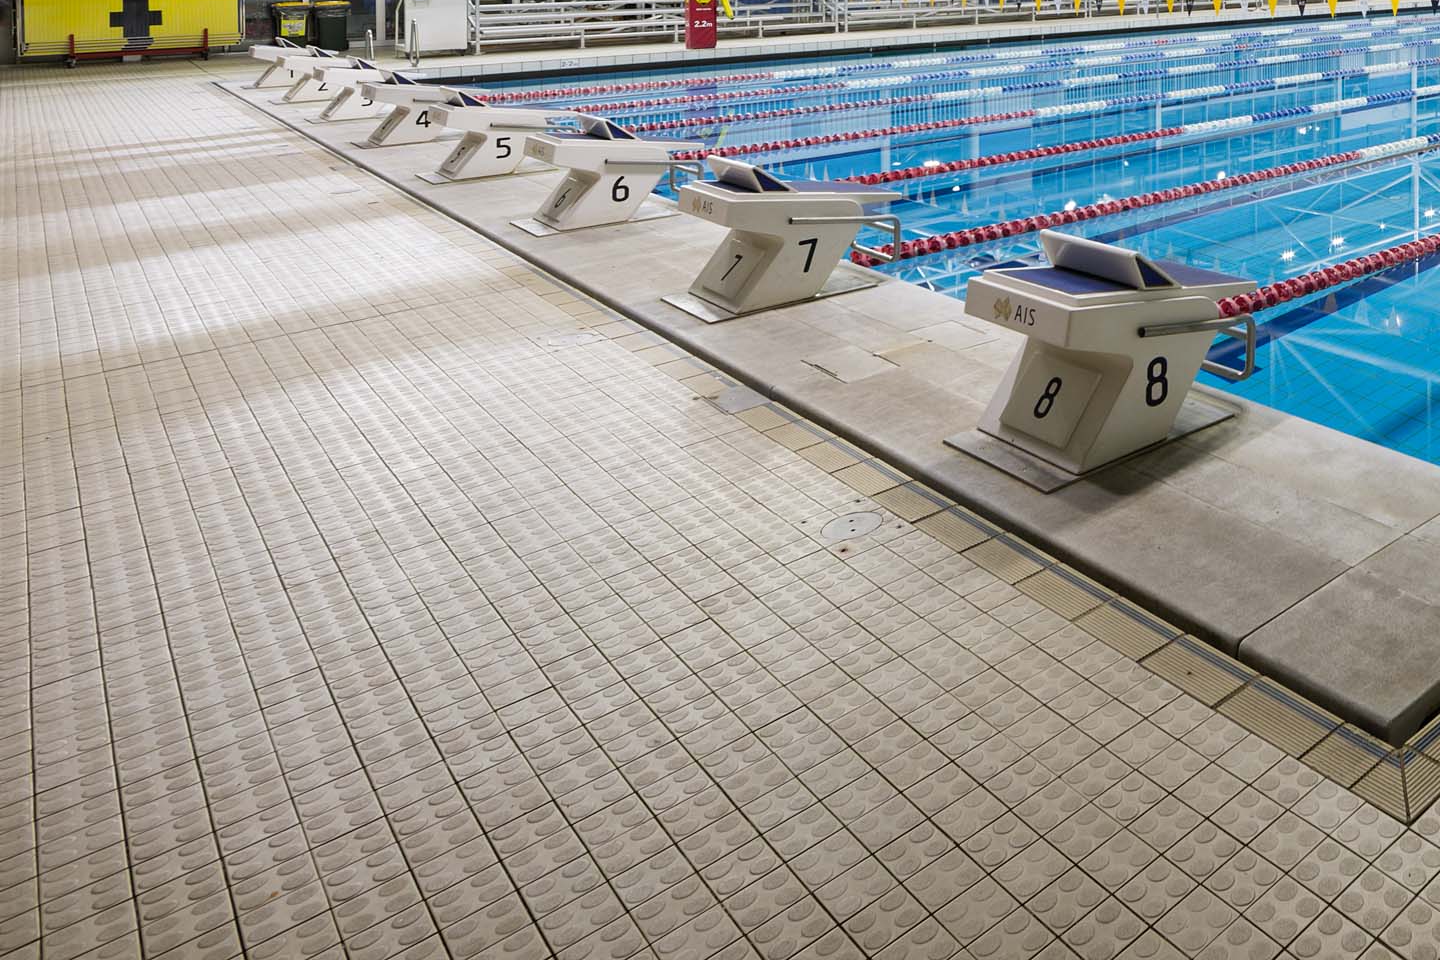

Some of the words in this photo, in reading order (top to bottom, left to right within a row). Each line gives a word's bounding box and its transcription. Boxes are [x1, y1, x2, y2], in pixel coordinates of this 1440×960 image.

[693, 20, 713, 28] 2.2m
[415, 110, 432, 129] 4
[495, 137, 512, 159] 5
[553, 187, 572, 209] 6
[611, 175, 630, 203] 6
[702, 200, 714, 215] AIS
[798, 237, 819, 273] 7
[720, 254, 743, 281] 7
[1013, 304, 1037, 327] AIS
[1145, 355, 1169, 408] 8
[1033, 376, 1063, 419] 8
